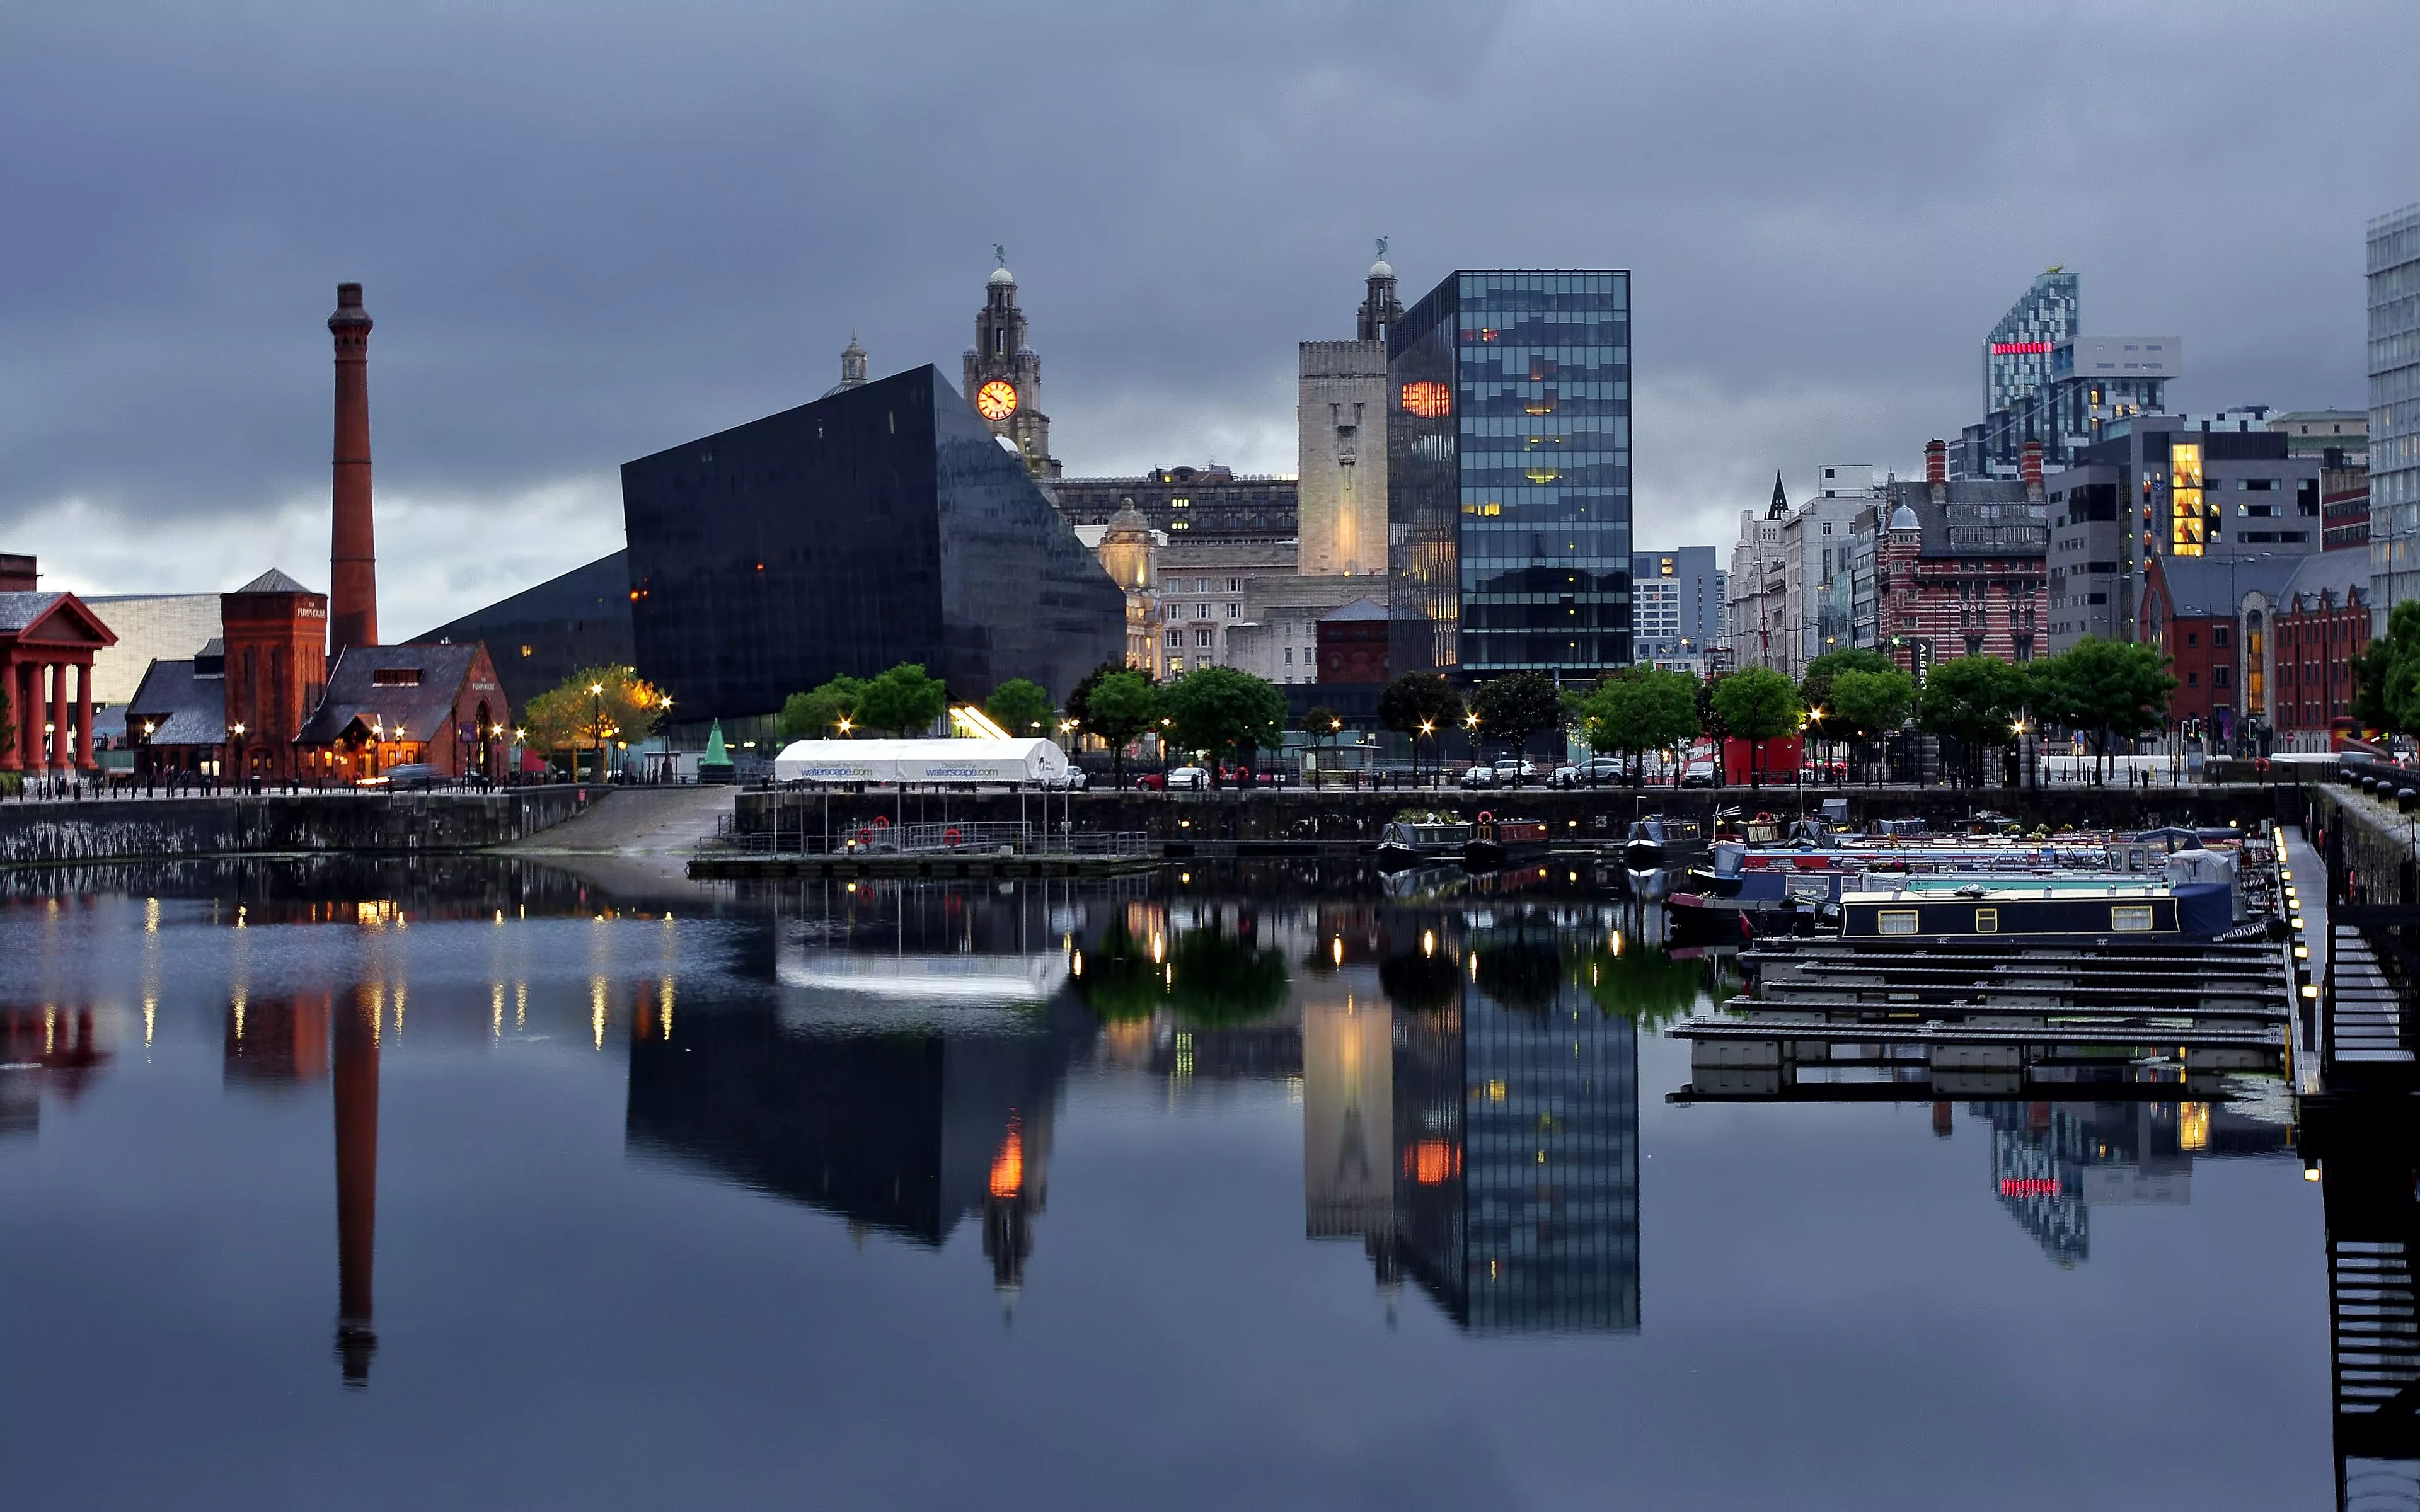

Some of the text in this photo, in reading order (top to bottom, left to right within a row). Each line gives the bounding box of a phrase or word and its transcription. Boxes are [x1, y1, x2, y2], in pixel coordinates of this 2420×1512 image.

[297, 607, 326, 619] PUMPHOUSE
[801, 767, 873, 777] waterscape.com
[926, 767, 998, 777] waterscape.com
